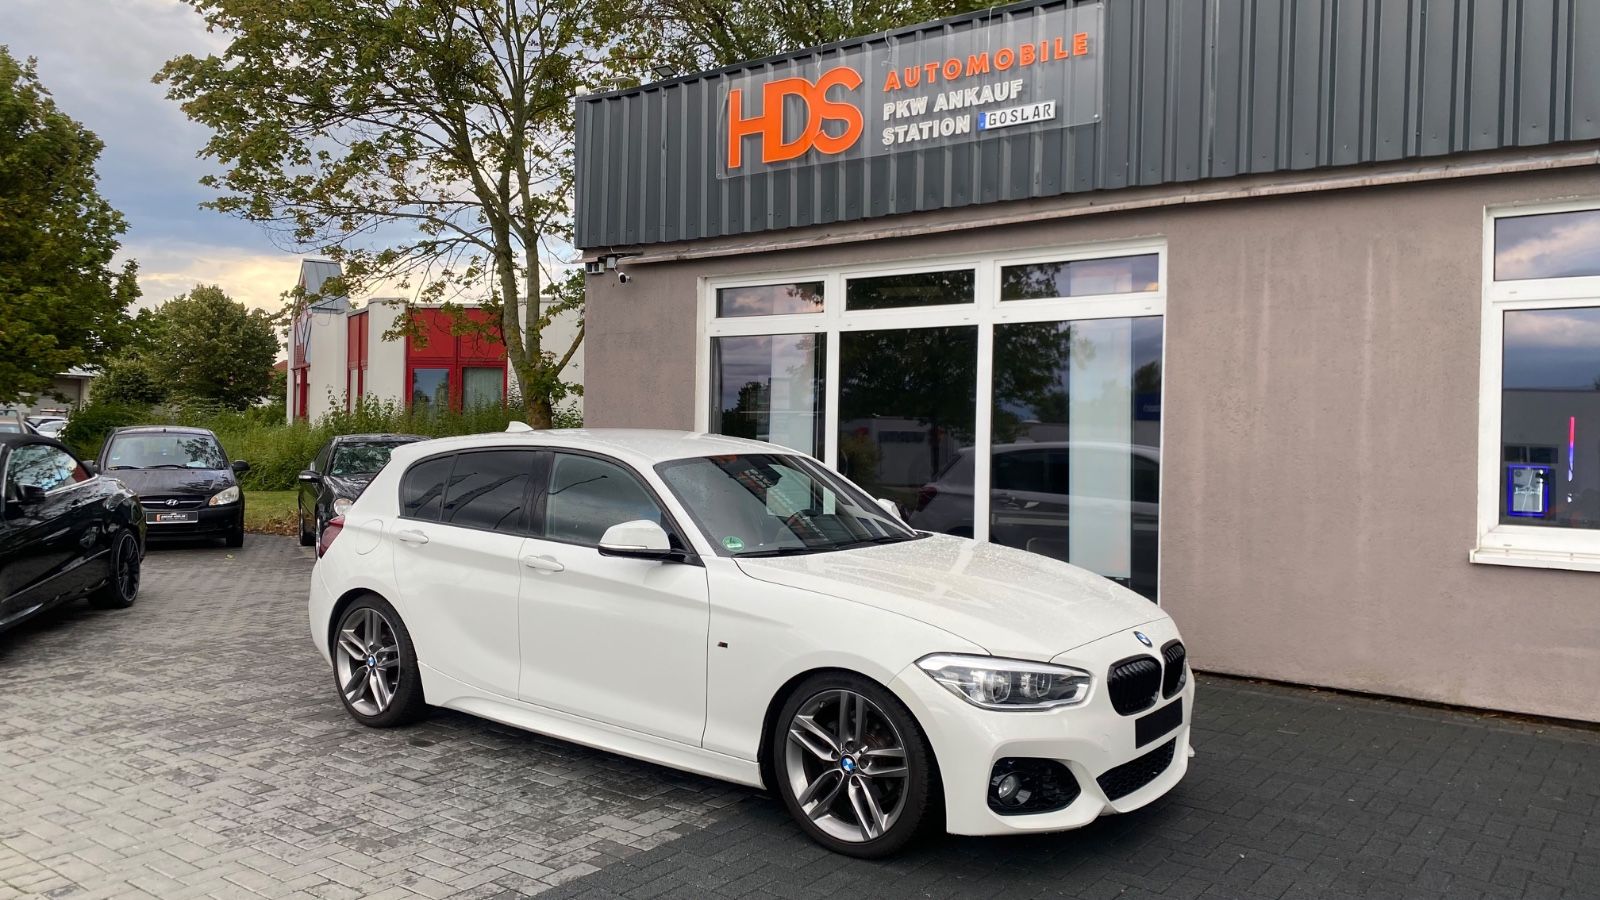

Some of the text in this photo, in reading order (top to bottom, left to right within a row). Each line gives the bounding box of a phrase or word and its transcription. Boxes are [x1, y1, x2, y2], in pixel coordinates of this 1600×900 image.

[883, 32, 1088, 92] AUTOMOBILE
[728, 66, 864, 168] HDS
[882, 103, 1052, 145] STATION GOSLAR
[883, 79, 1024, 121] PKW ANKAUF
